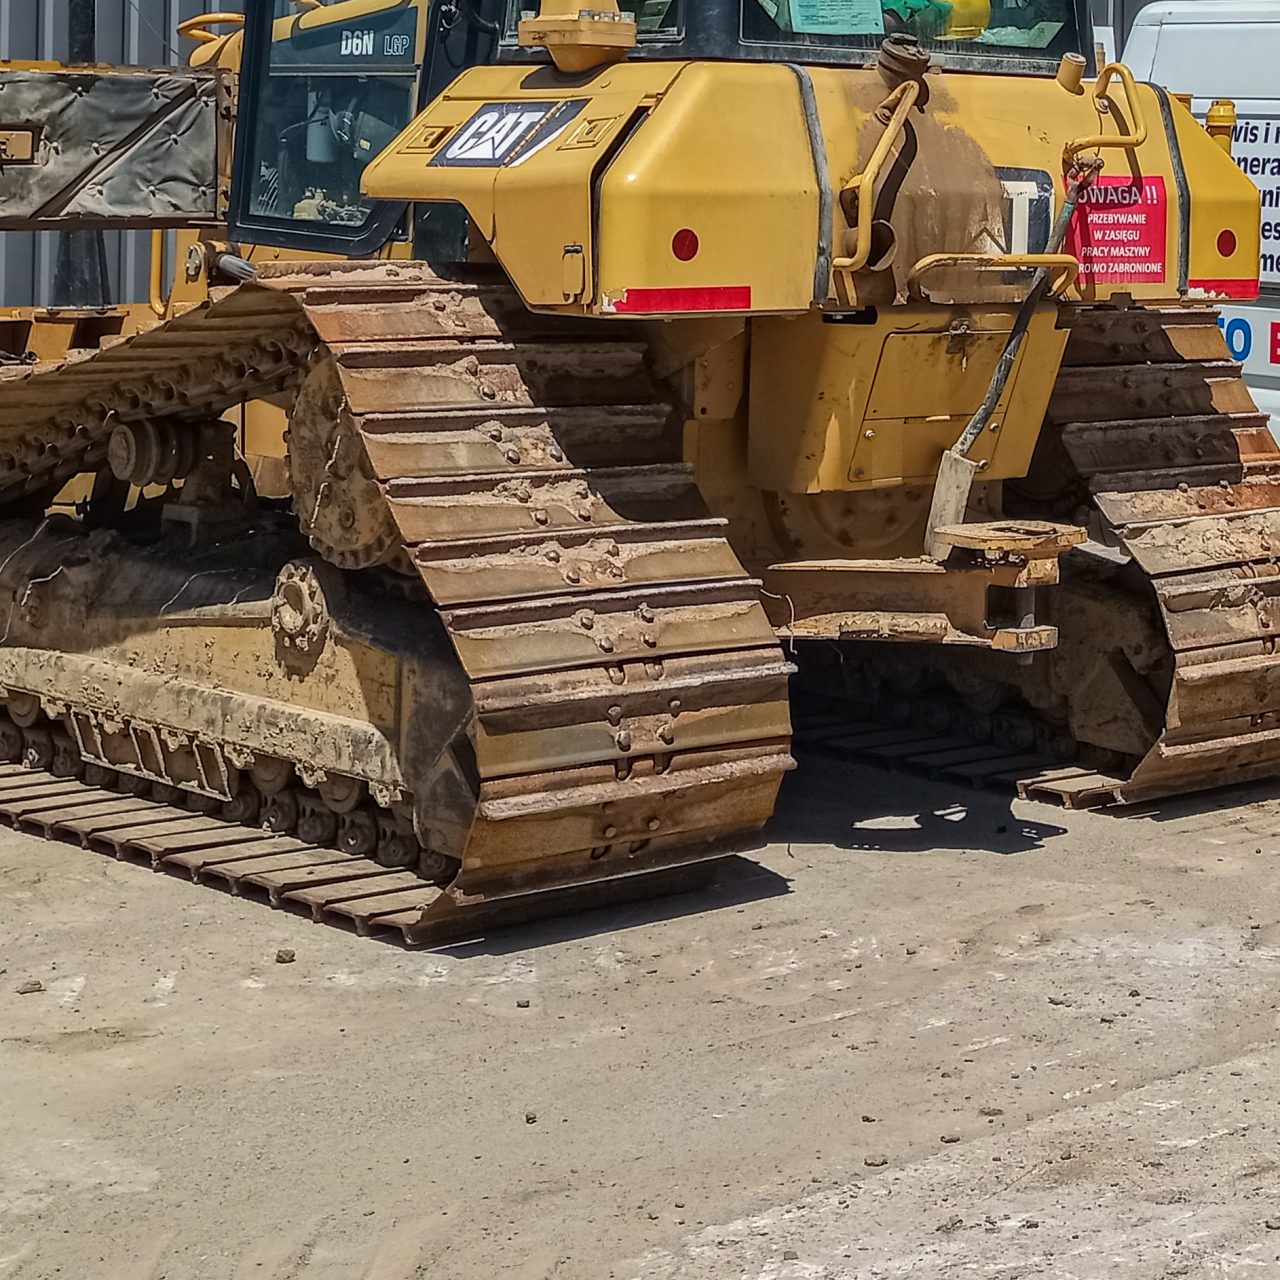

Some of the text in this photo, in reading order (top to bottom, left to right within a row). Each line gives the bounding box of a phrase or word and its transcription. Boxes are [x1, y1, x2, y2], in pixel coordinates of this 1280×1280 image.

[341, 30, 410, 55] D6N LGP
[446, 112, 545, 159] CAT
[1264, 123, 1271, 144] i
[1087, 213, 1147, 224] PRZEBYWANIE
[1093, 230, 1139, 242] W ZASIĘGU
[1081, 246, 1150, 257] PRACY MASZYNY
[1079, 262, 1162, 273] ROWO ZABRONIONE
